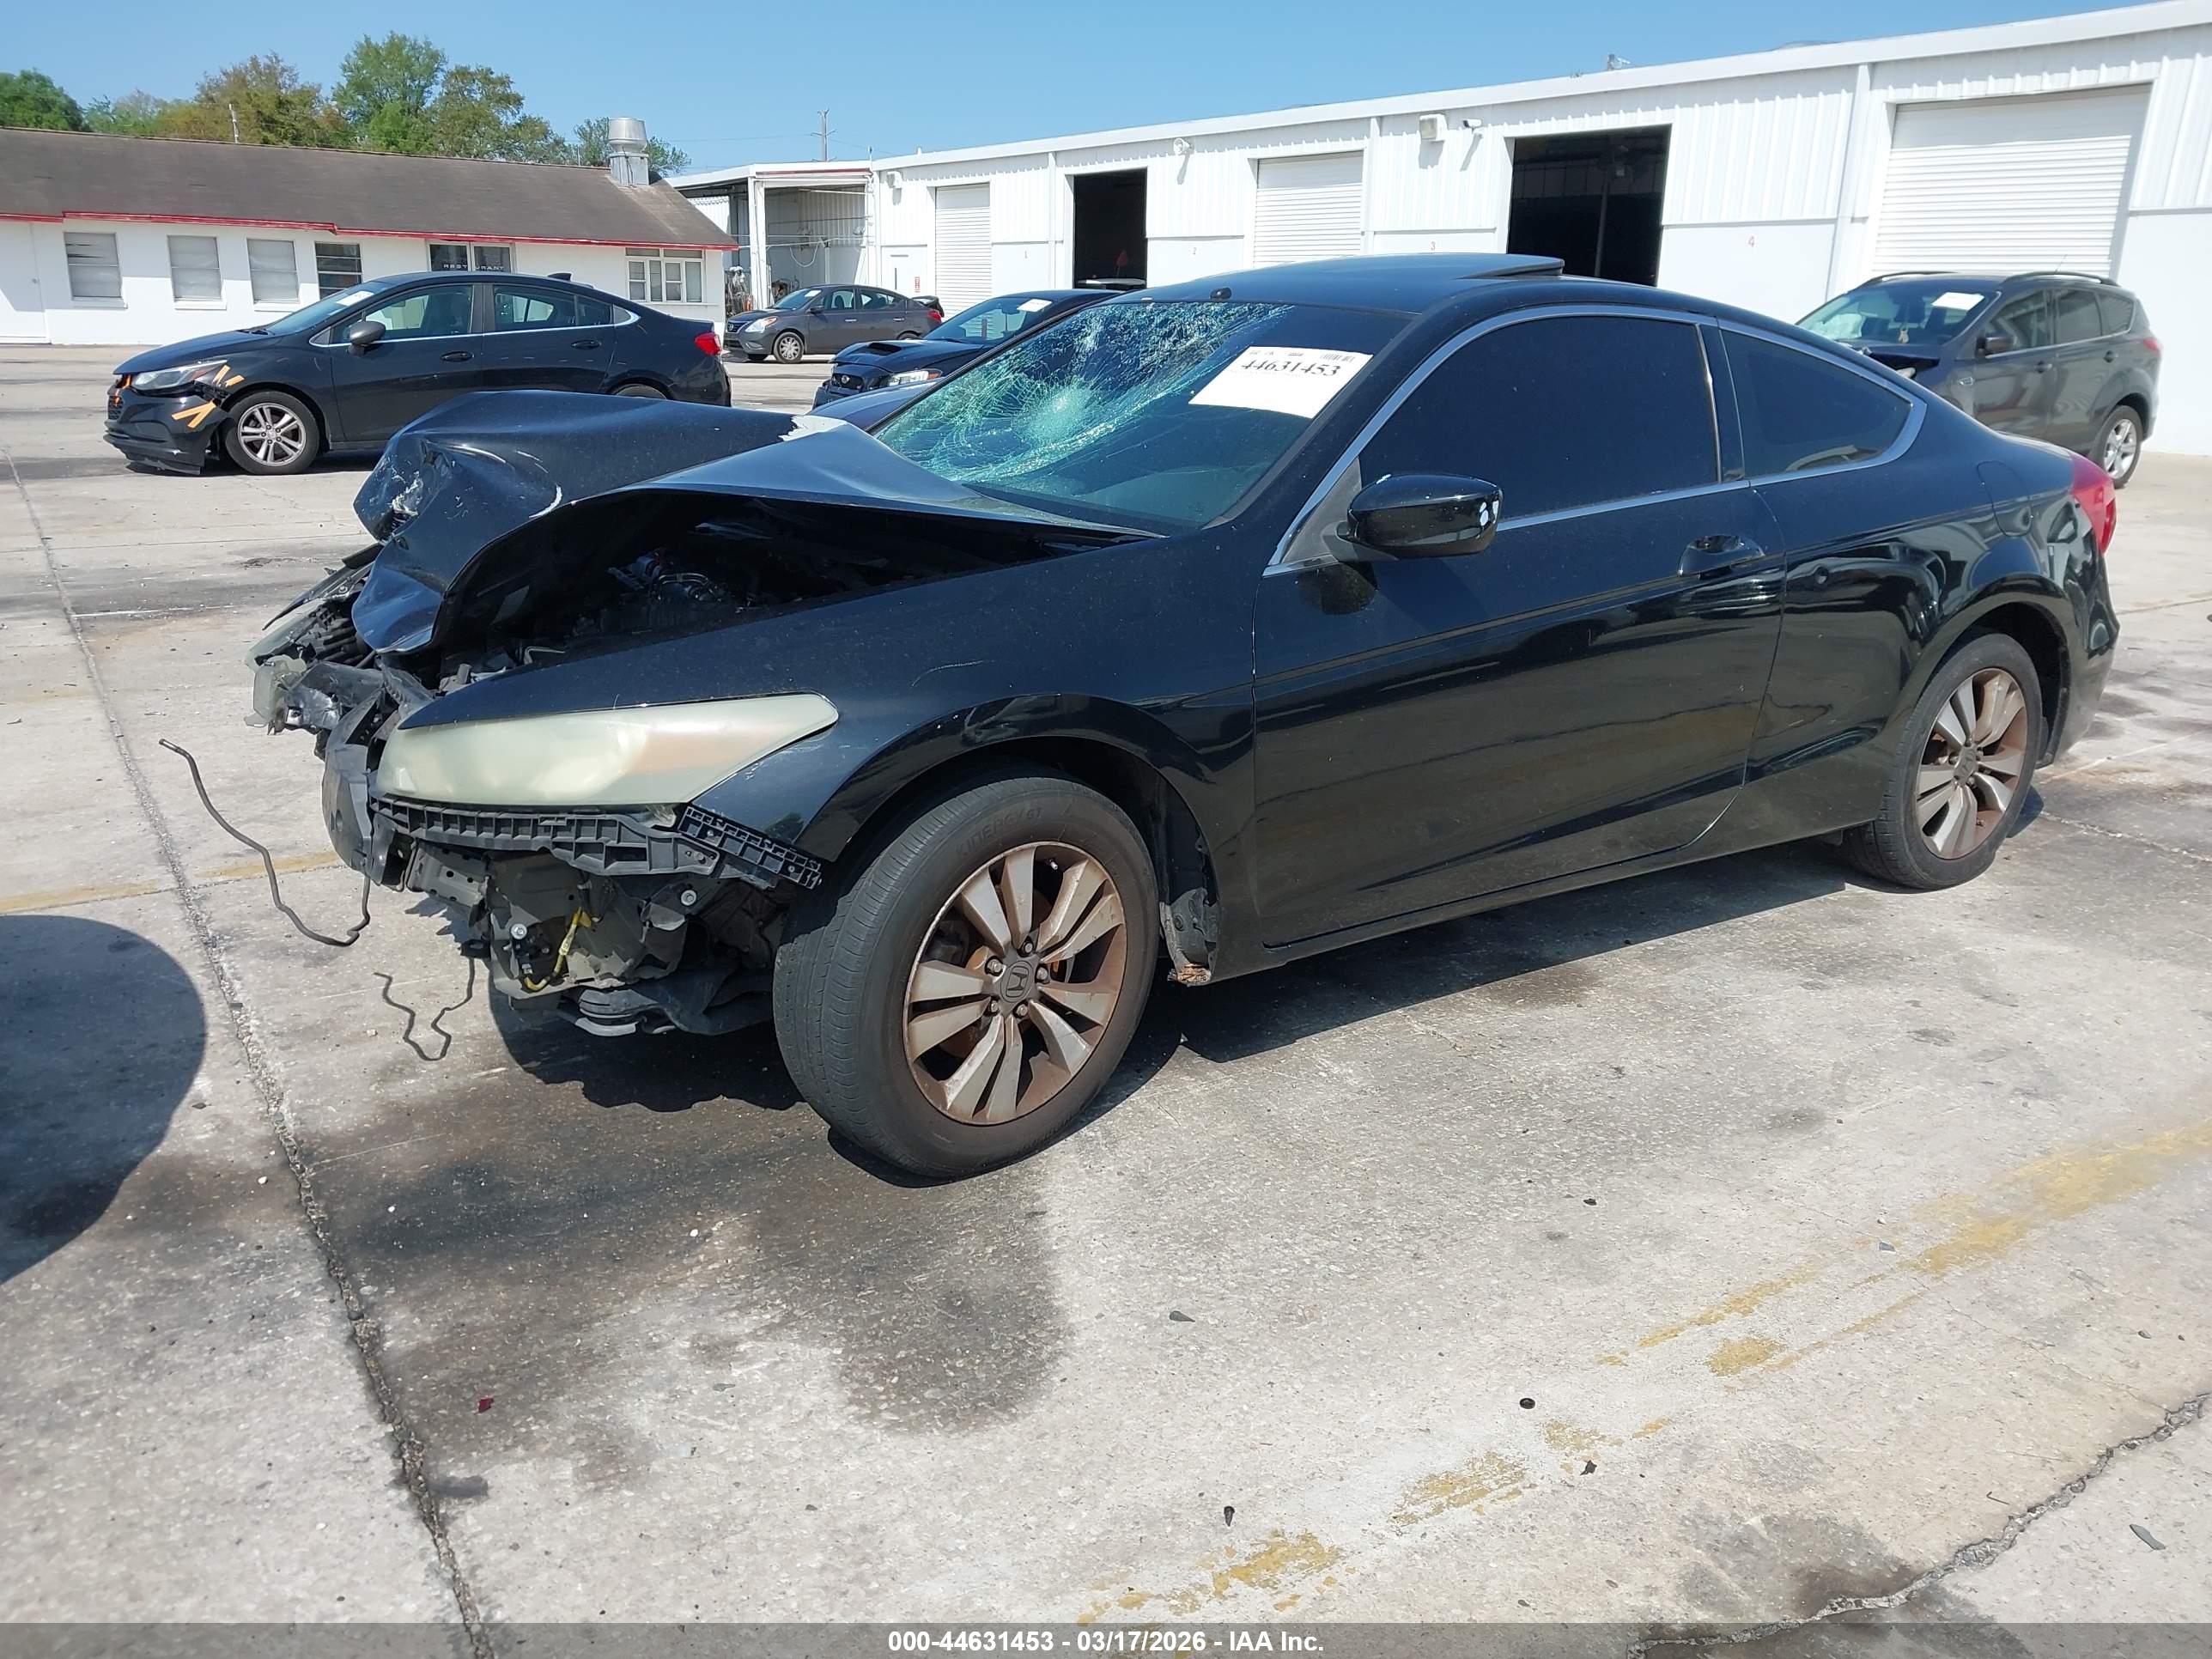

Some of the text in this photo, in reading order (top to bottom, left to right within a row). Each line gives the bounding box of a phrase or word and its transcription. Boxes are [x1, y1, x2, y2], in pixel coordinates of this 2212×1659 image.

[1430, 240, 1436, 251] 3
[1747, 236, 1755, 248] 4
[1242, 360, 1341, 376] 44631453
